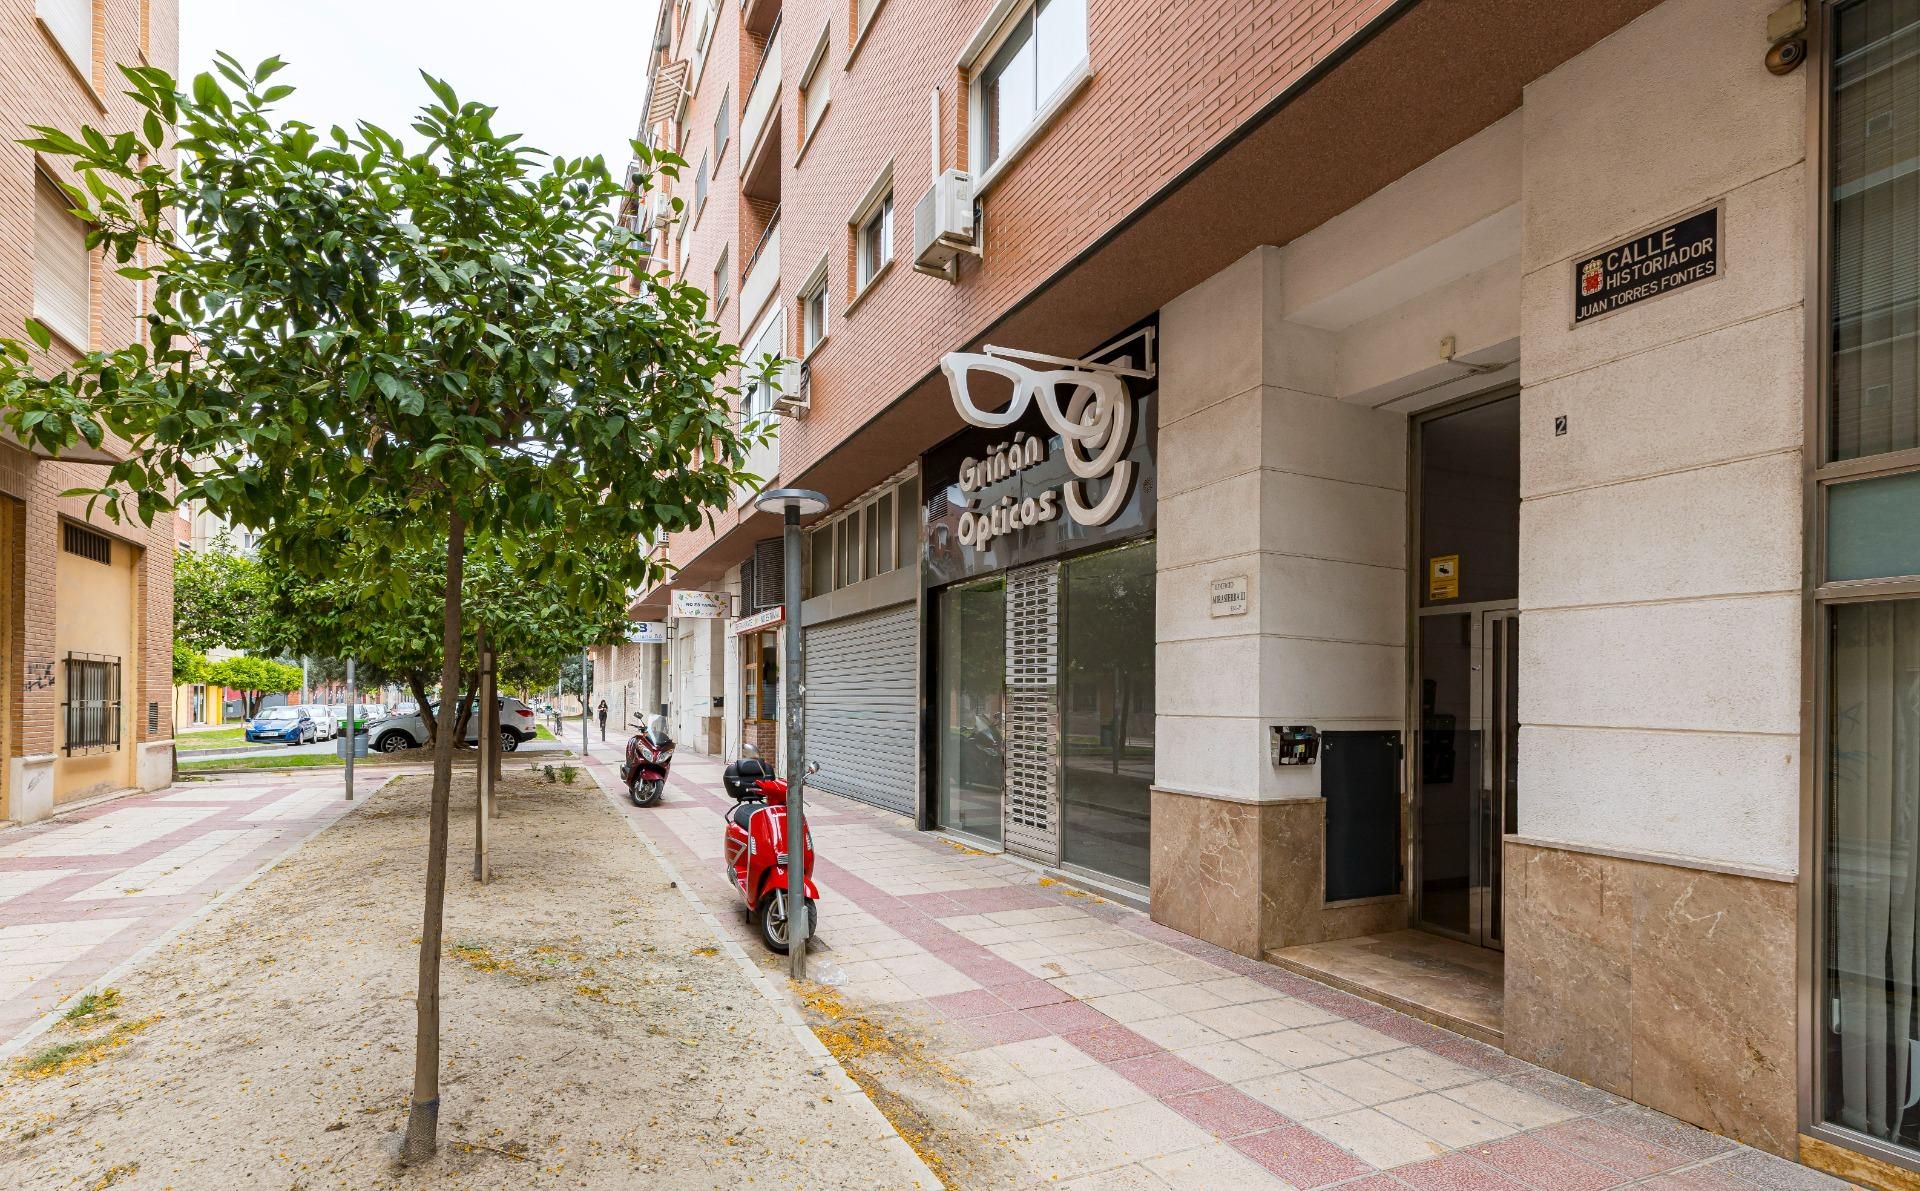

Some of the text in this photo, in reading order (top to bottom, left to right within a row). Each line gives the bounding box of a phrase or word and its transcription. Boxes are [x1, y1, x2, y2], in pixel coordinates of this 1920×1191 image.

[1606, 237, 1713, 290] HISTORIADOR
[1607, 228, 1676, 271] CALLE
[1576, 260, 1714, 319] JUAN TORRES FONTES
[1557, 418, 1566, 435] 2
[959, 431, 1044, 492] Griñán
[958, 490, 1057, 551] Ópticos
